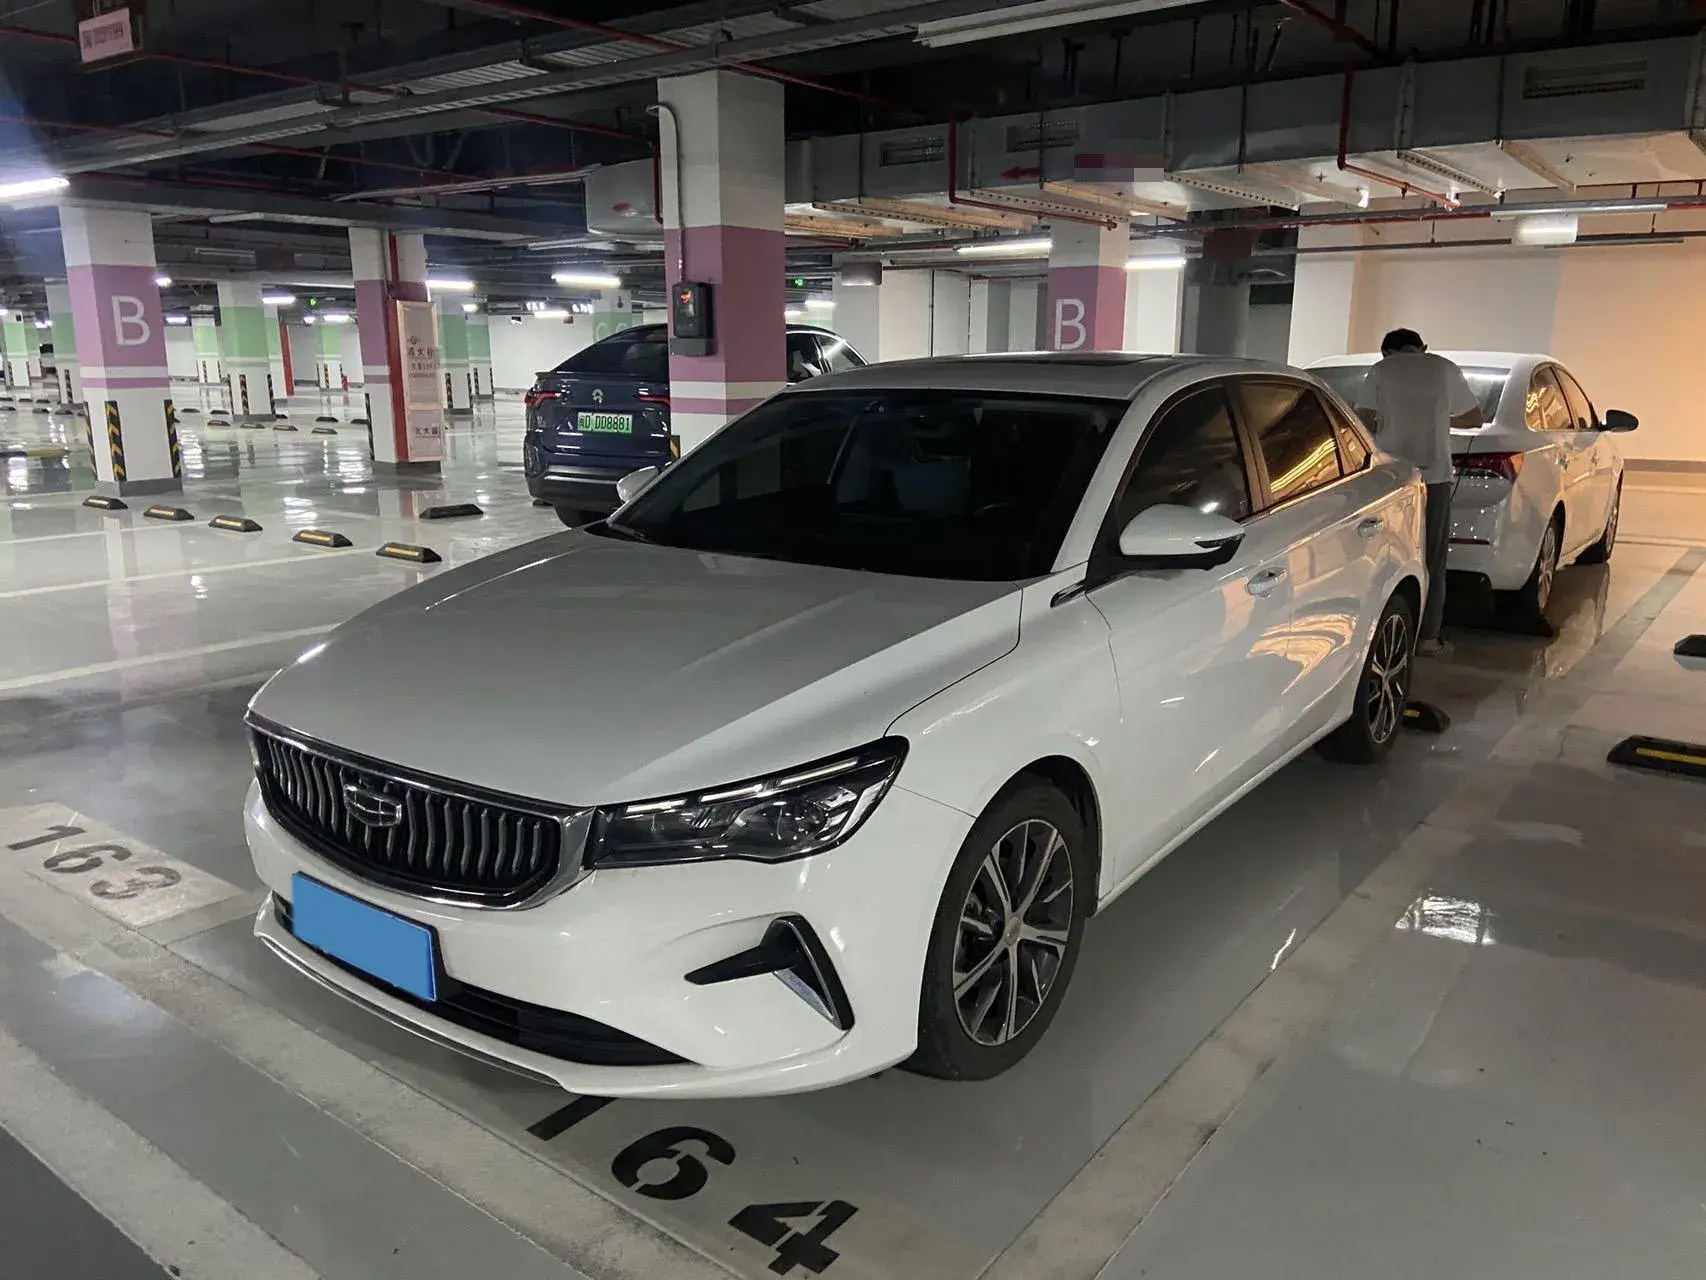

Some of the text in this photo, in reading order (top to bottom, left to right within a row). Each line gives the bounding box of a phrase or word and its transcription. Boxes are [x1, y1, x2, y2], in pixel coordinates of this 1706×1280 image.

[112, 295, 150, 345] B
[1055, 299, 1086, 350] B
[8, 825, 182, 899] 163
[526, 1097, 858, 1275] 164
